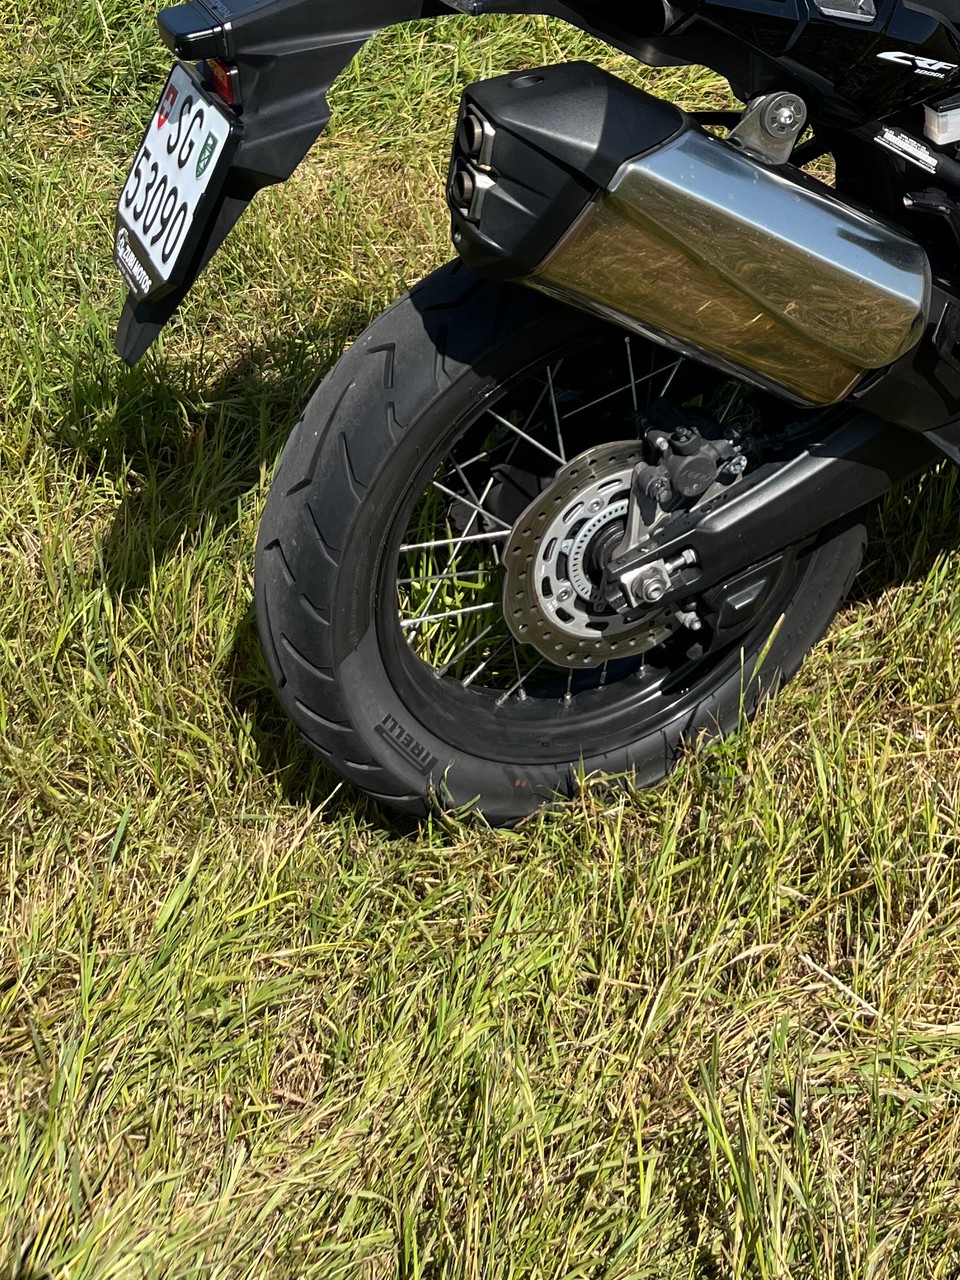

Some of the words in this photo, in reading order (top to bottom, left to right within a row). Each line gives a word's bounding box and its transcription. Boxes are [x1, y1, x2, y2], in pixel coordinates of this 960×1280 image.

[876, 51, 958, 70] CRF
[913, 68, 945, 79] 1000L
[166, 94, 204, 169] SG
[124, 145, 188, 265] 53090
[132, 260, 152, 294] MOTOS
[374, 713, 439, 777] PIRELLI
